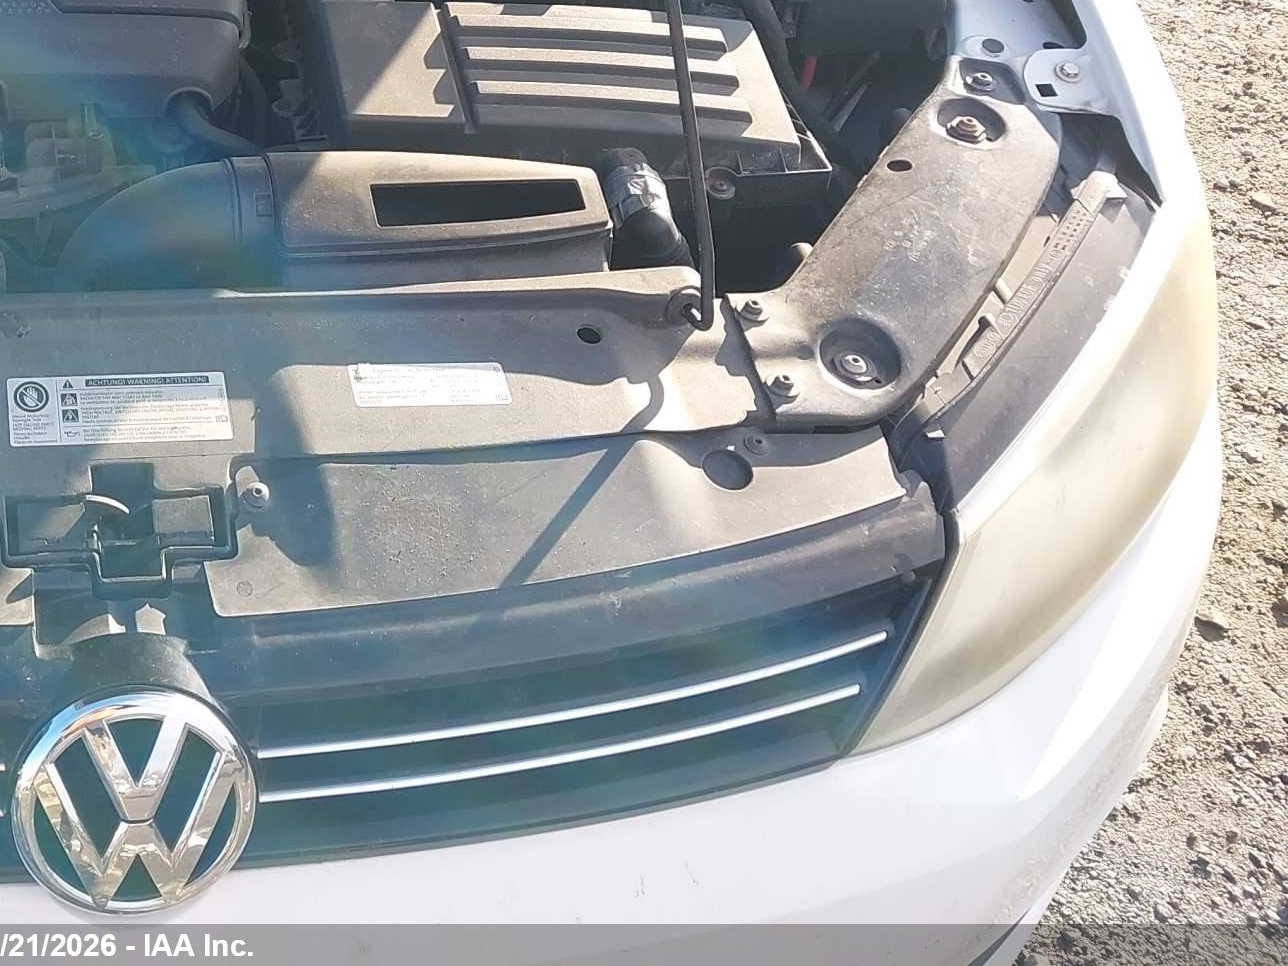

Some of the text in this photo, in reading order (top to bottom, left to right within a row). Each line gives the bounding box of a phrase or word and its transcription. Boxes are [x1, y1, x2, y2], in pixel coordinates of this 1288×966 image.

[88, 376, 207, 387] ACHTUNG! WARNING! ATTENTION!
[26, 706, 244, 911] VW
